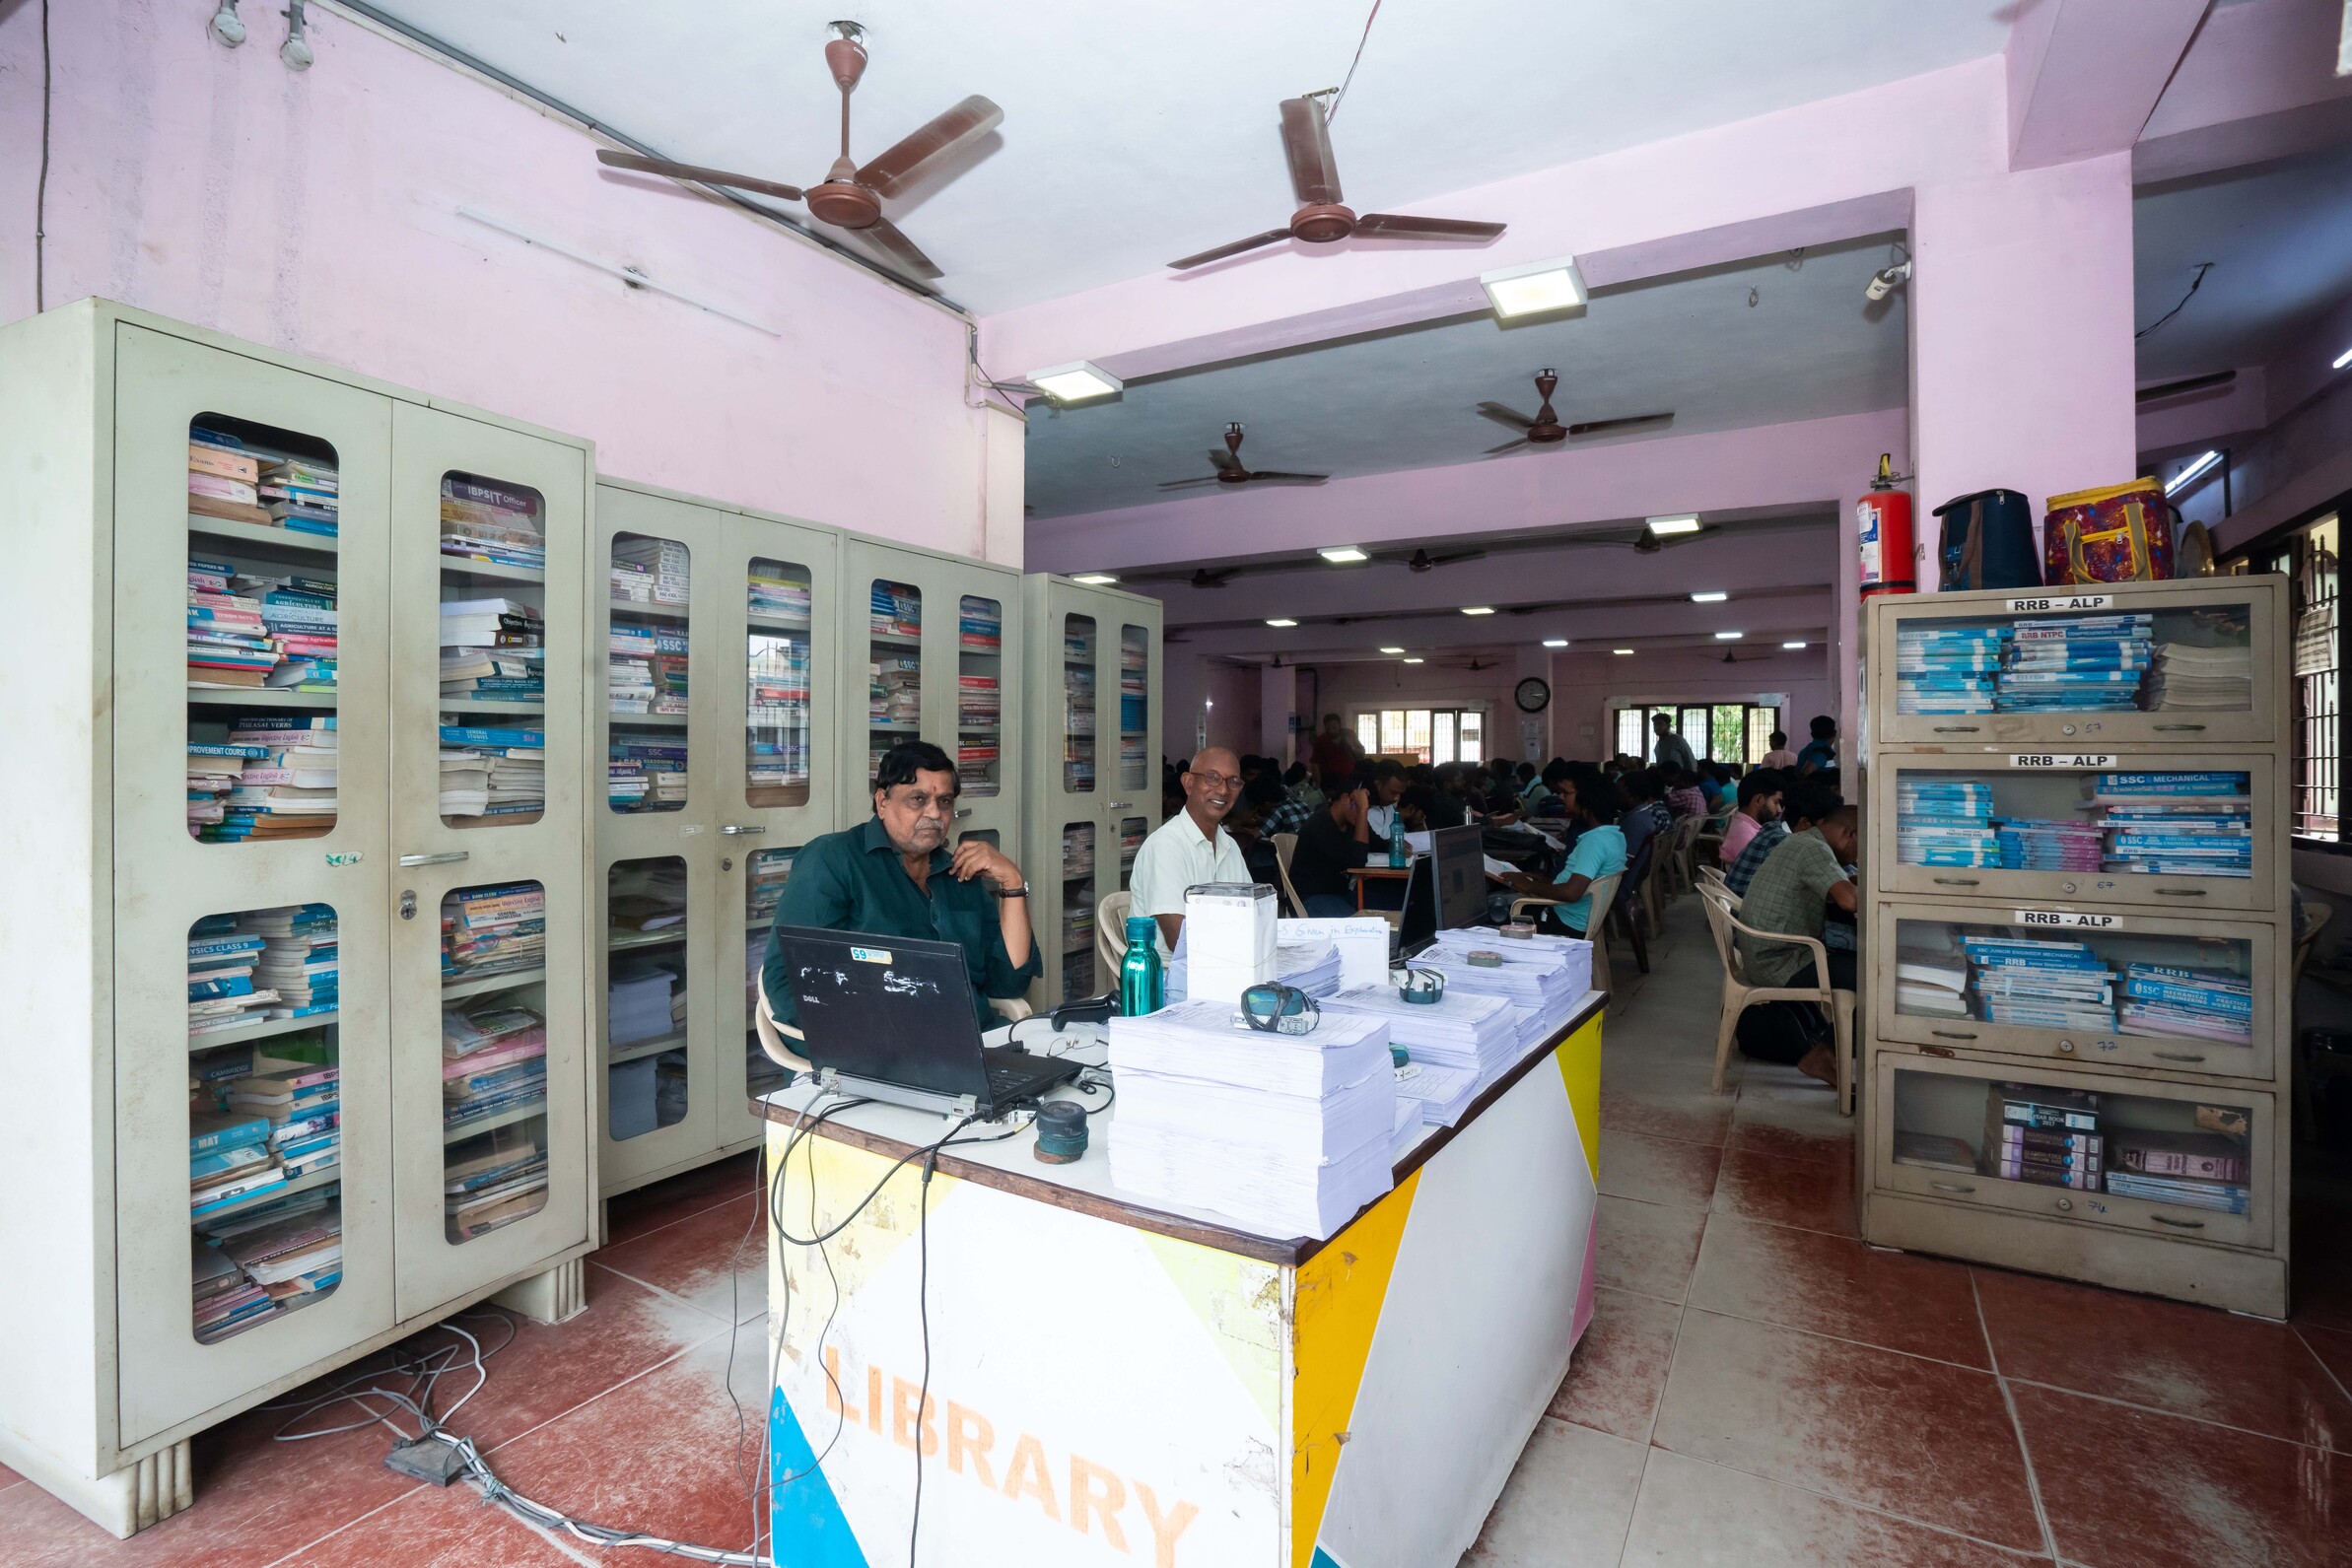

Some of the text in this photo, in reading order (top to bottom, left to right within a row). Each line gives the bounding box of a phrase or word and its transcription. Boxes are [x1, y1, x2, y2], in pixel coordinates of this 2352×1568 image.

[467, 485, 490, 499] IBPS
[503, 496, 526, 507] Officer
[275, 600, 322, 610] AGRICULTURE
[2014, 600, 2050, 611] RRB
[2069, 597, 2104, 608] ALP
[271, 613, 324, 622] AGRICULTURE
[663, 640, 682, 651] SSC
[904, 660, 915, 669] SSC
[224, 748, 246, 757] COURSE
[2018, 755, 2054, 766] RRB
[2073, 756, 2108, 766] ALP
[2120, 776, 2145, 784] SSC
[2024, 913, 2061, 924] RRB
[2077, 915, 2112, 927] ALP
[1296, 924, 1324, 936] Given
[1330, 925, 1340, 935] in
[217, 943, 241, 952] CLASS
[2153, 966, 2190, 978] RRB
[2143, 986, 2247, 1007] SSC MECHANICAL PRACTICE
[2163, 994, 2208, 1005] ENGINEERING
[210, 1064, 249, 1078] CAMBRIDGE
[198, 1135, 219, 1149] MAT
[825, 1344, 1200, 1568] LIBRARY
